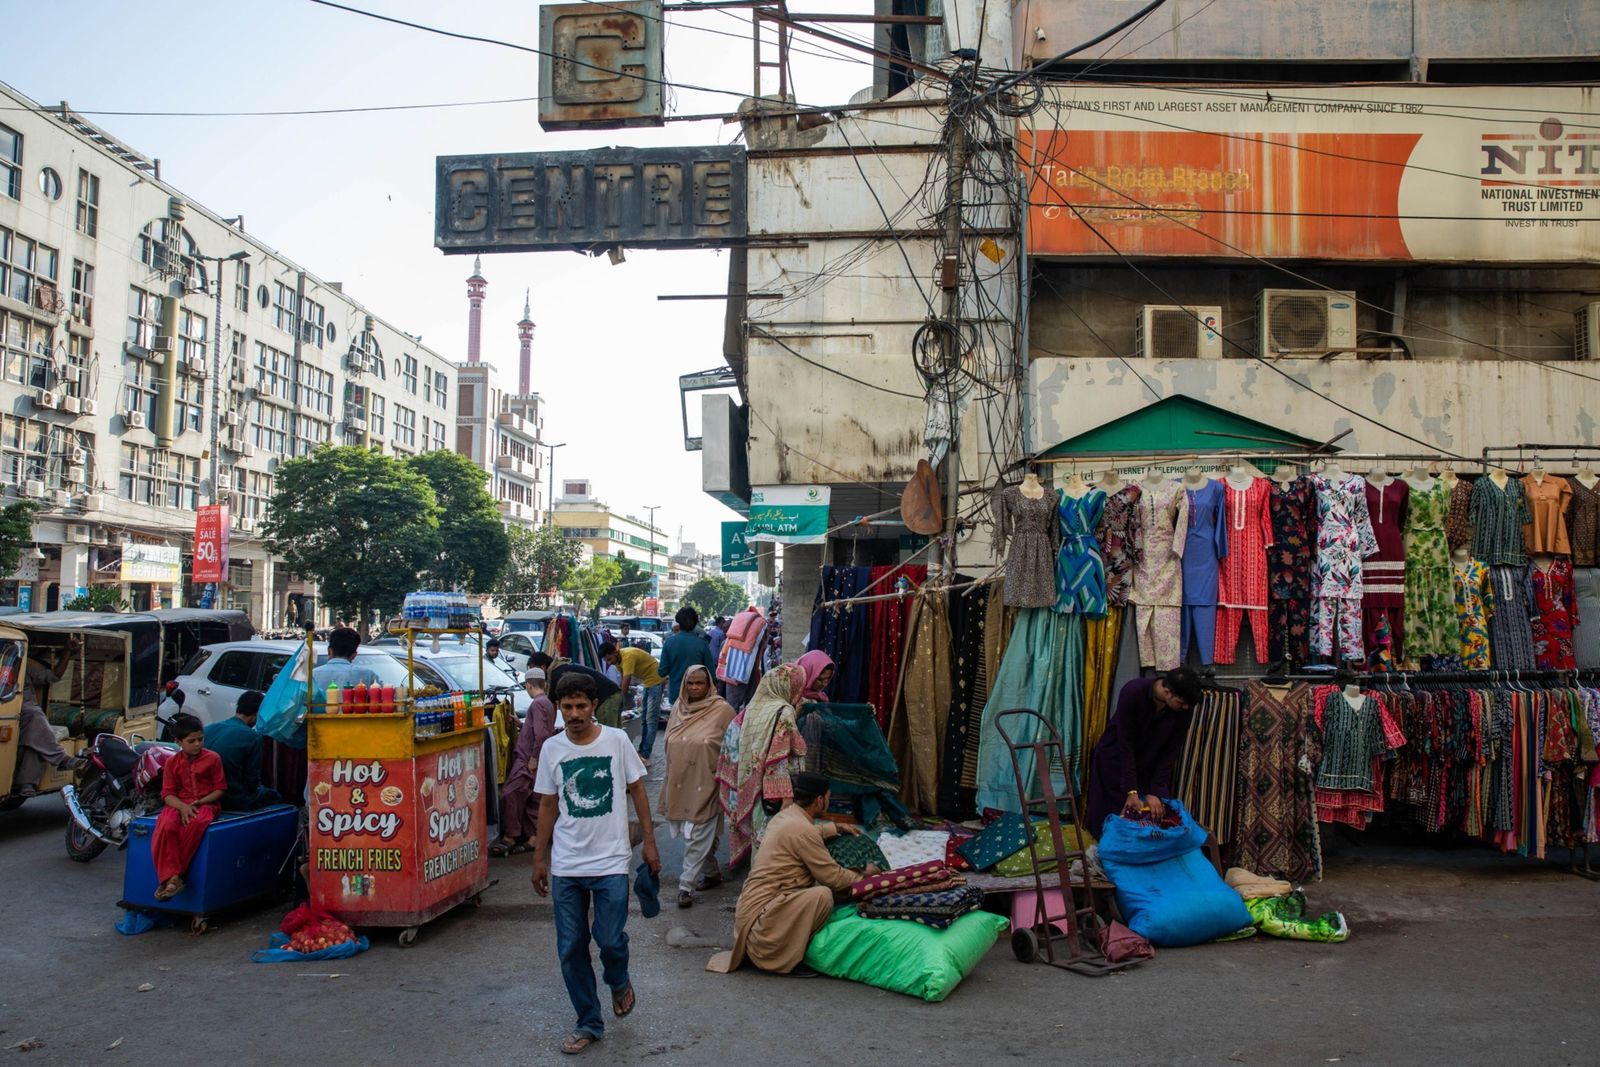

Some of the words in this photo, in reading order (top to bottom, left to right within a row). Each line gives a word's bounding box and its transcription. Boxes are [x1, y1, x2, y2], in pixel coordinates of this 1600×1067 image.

[553, 14, 646, 104] C
[1043, 100, 1101, 111] PAKISTAN'S
[1103, 101, 1131, 111] FIRST
[1134, 101, 1155, 111] AND
[1158, 102, 1203, 112] LARGEST
[1206, 103, 1237, 112] ASSET
[1240, 103, 1310, 113] MANAGEMENT
[1314, 104, 1363, 113] COMPANY
[1366, 104, 1396, 113] SINCE
[1401, 104, 1423, 113] 1962
[448, 160, 731, 232] CENTRE
[1481, 189, 1533, 199] NATIONAL
[1502, 202, 1537, 212] TRUST
[1540, 202, 1583, 212] LIMITED
[1505, 219, 1536, 227] INVEST
[1540, 219, 1548, 227] IN
[1551, 219, 1579, 227] TRUST
[1115, 466, 1145, 475] NTERNET
[200, 530, 217, 539] SALE
[777, 523, 798, 532] ATM
[332, 760, 386, 784] Hot
[437, 753, 463, 781] Hot
[351, 788, 365, 804] &
[448, 784, 456, 802] &
[317, 808, 401, 838] Spicy
[429, 805, 470, 842] Spicy
[317, 849, 364, 871] FRENCH
[368, 849, 401, 871] FRIES
[424, 851, 457, 883] FRENCH
[459, 840, 480, 864] FRIES
